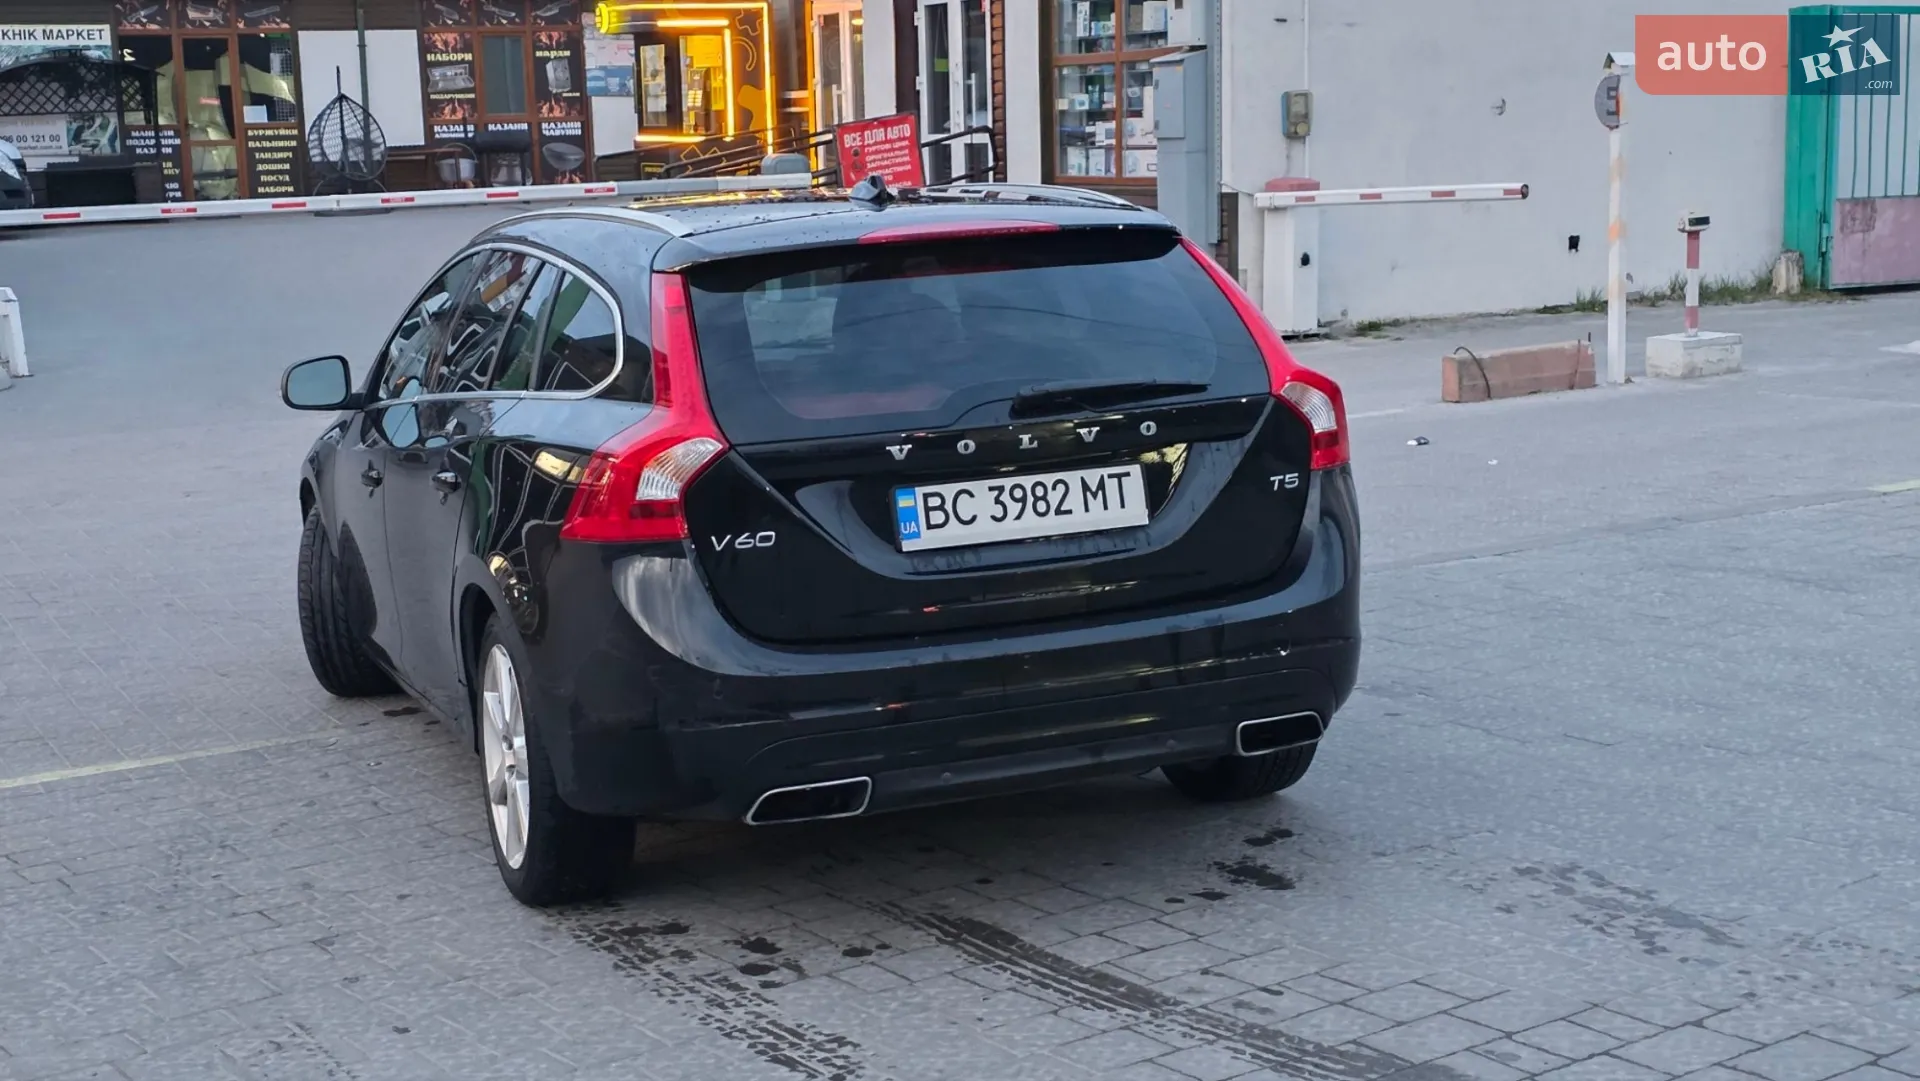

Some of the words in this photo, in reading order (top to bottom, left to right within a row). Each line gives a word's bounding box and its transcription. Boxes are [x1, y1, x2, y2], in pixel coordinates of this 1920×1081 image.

[42, 28, 105, 41] МАРКЕТ
[427, 53, 473, 62] НАБОРИ
[488, 122, 529, 132] КАЗАНИ
[541, 121, 582, 130] КАЗАНИ
[247, 127, 299, 136] БУРЖУЙКИ
[844, 132, 863, 148] ВСЕ
[864, 128, 885, 146] ДЛЯ
[887, 124, 911, 140] АВТО
[16, 134, 28, 143] 00
[31, 134, 45, 142] 121
[49, 134, 61, 142] 00
[125, 138, 181, 146] ПОДАРНКИ
[248, 140, 298, 148] ПАЛЬНИКИ
[256, 163, 291, 171] ДОШКИ
[260, 174, 290, 182] ПОСУД
[885, 421, 1157, 461] VOLVO
[1269, 472, 1299, 491] T5
[922, 488, 978, 531] BC
[987, 478, 1073, 523] 3982
[1080, 471, 1131, 514] MT
[901, 522, 919, 535] UA
